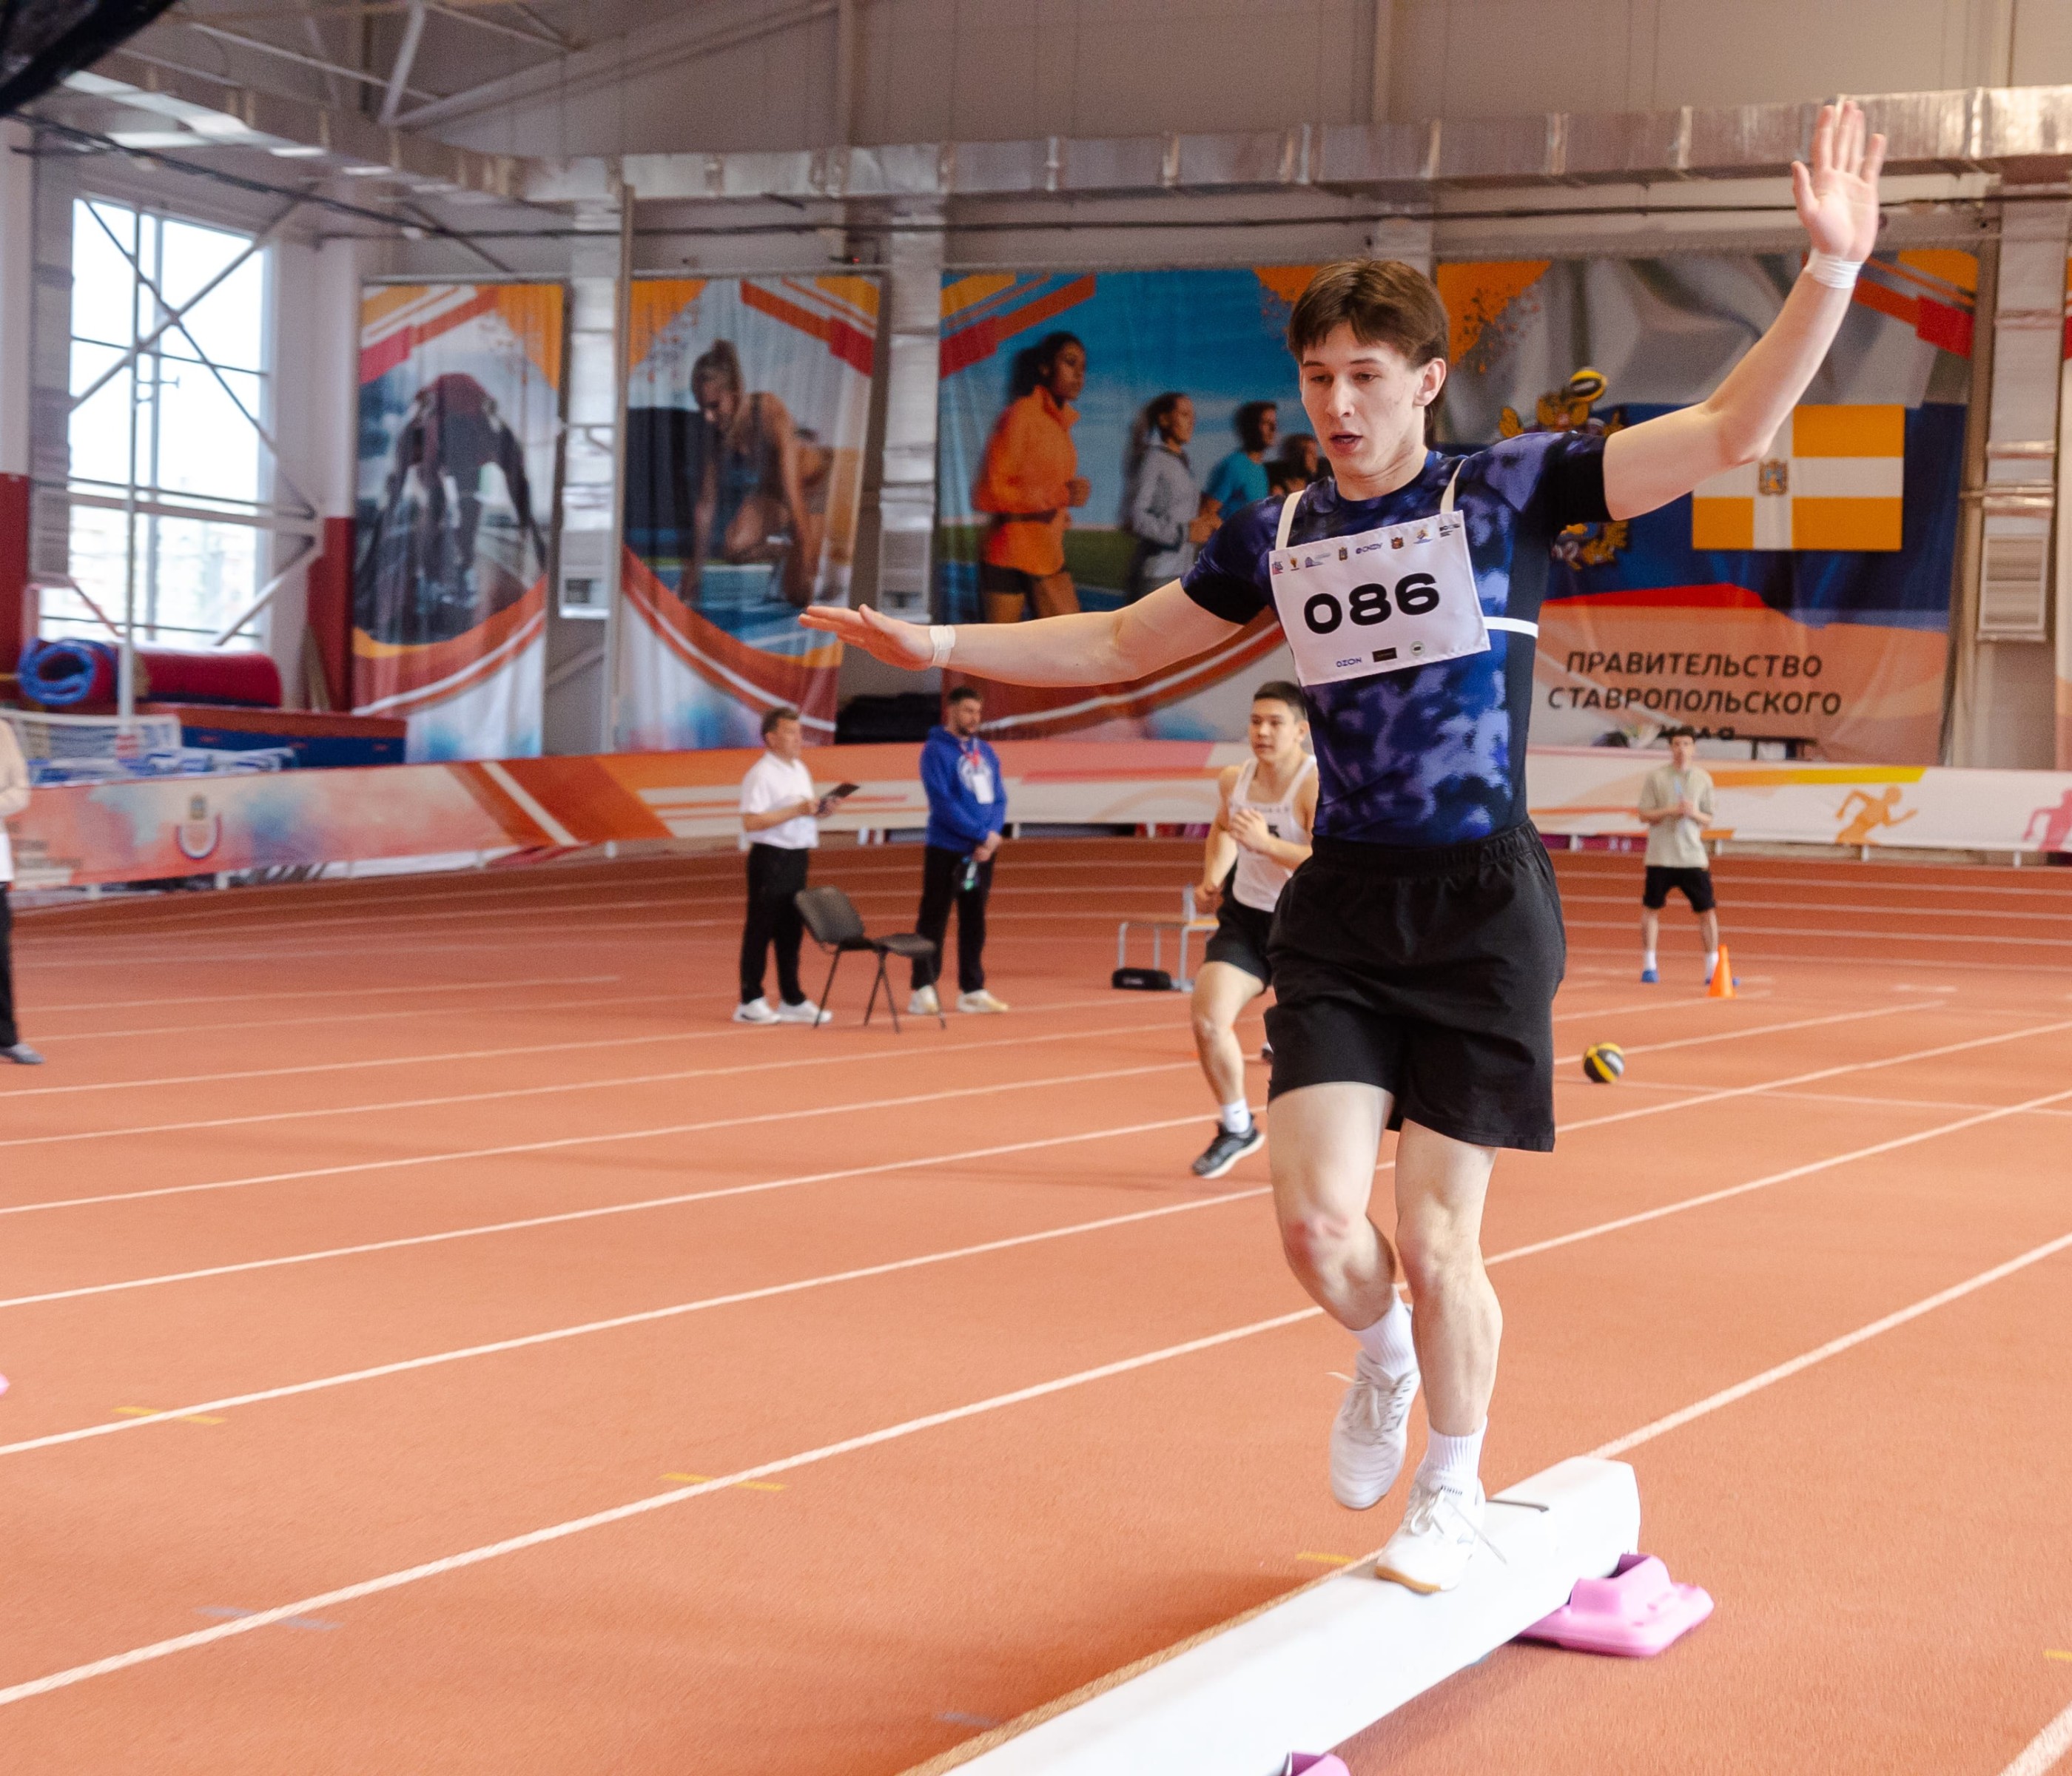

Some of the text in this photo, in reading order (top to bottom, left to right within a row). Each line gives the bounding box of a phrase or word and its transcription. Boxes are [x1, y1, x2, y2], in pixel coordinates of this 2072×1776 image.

[1303, 572, 1440, 634] 086
[1336, 657, 1362, 667] OZON
[1566, 650, 1823, 679] ПРАВИТЕЛЬСТВО
[1547, 686, 1843, 716] СТАВРОПОЛЬСКОГО
